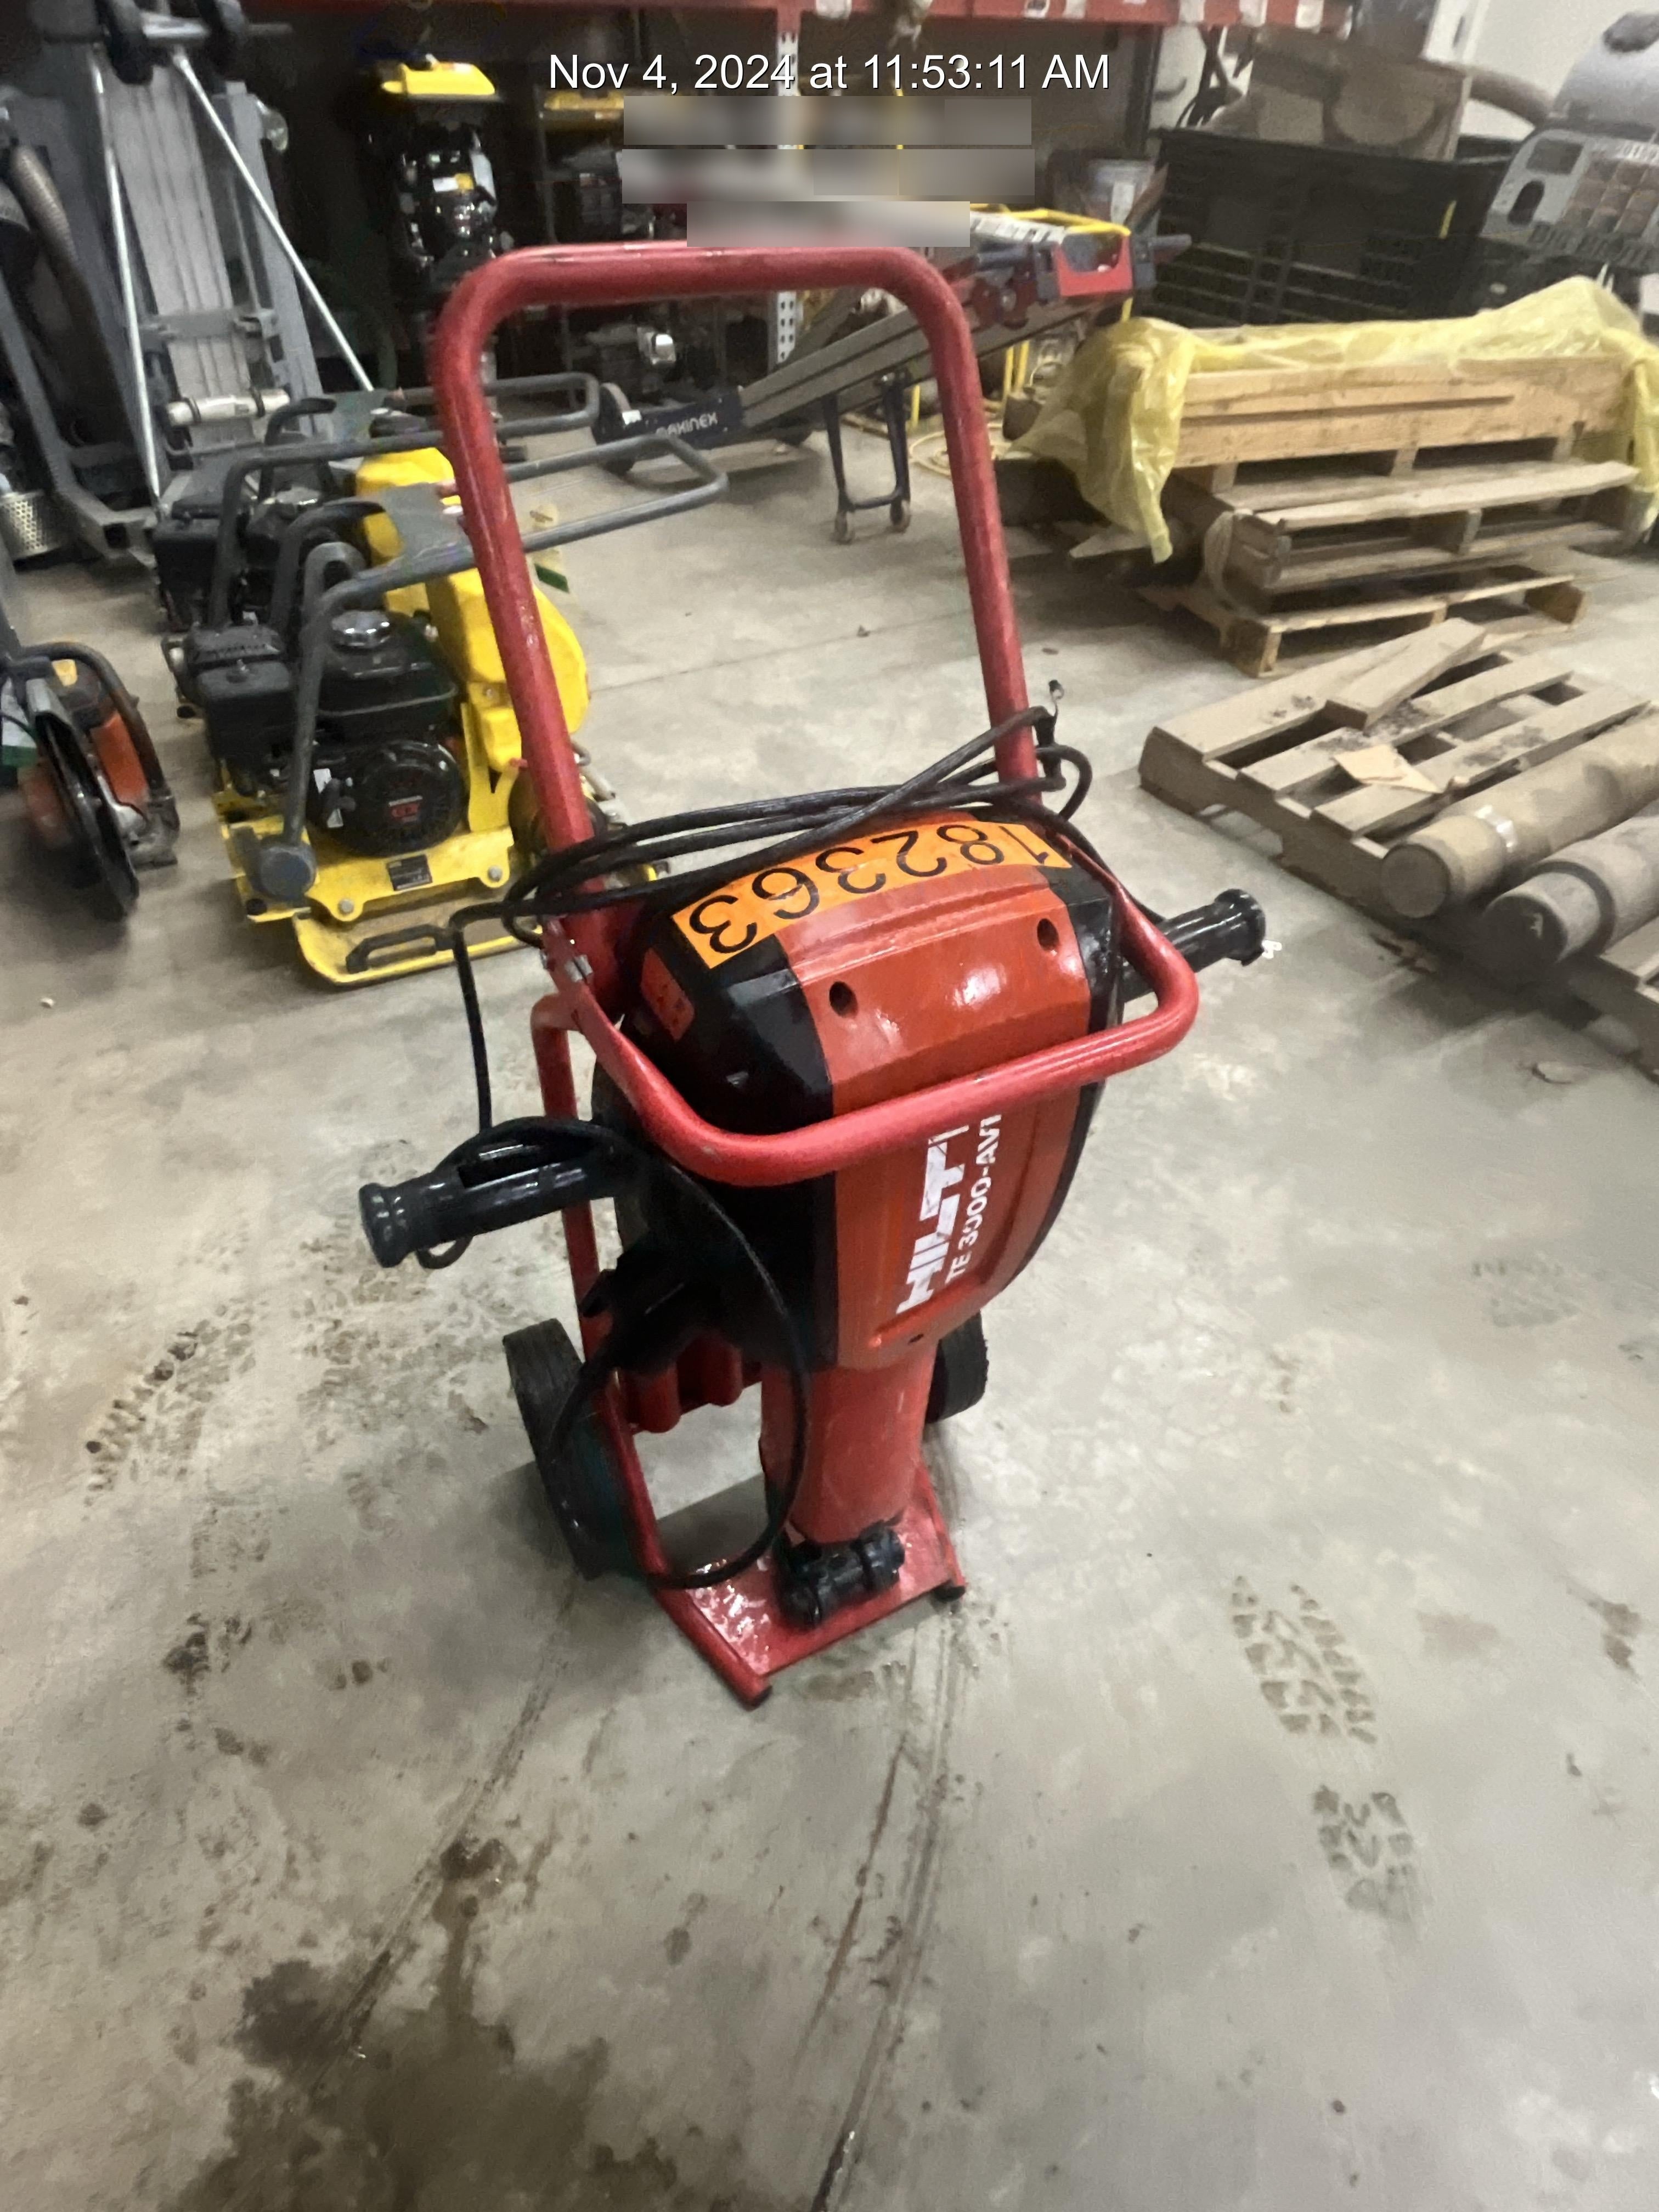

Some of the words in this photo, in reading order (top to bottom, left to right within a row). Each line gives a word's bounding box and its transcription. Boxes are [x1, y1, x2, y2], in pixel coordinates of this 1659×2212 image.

[689, 824, 1048, 954] 182363
[896, 1125, 969, 1314] HILTI
[945, 1251, 971, 1284] TE
